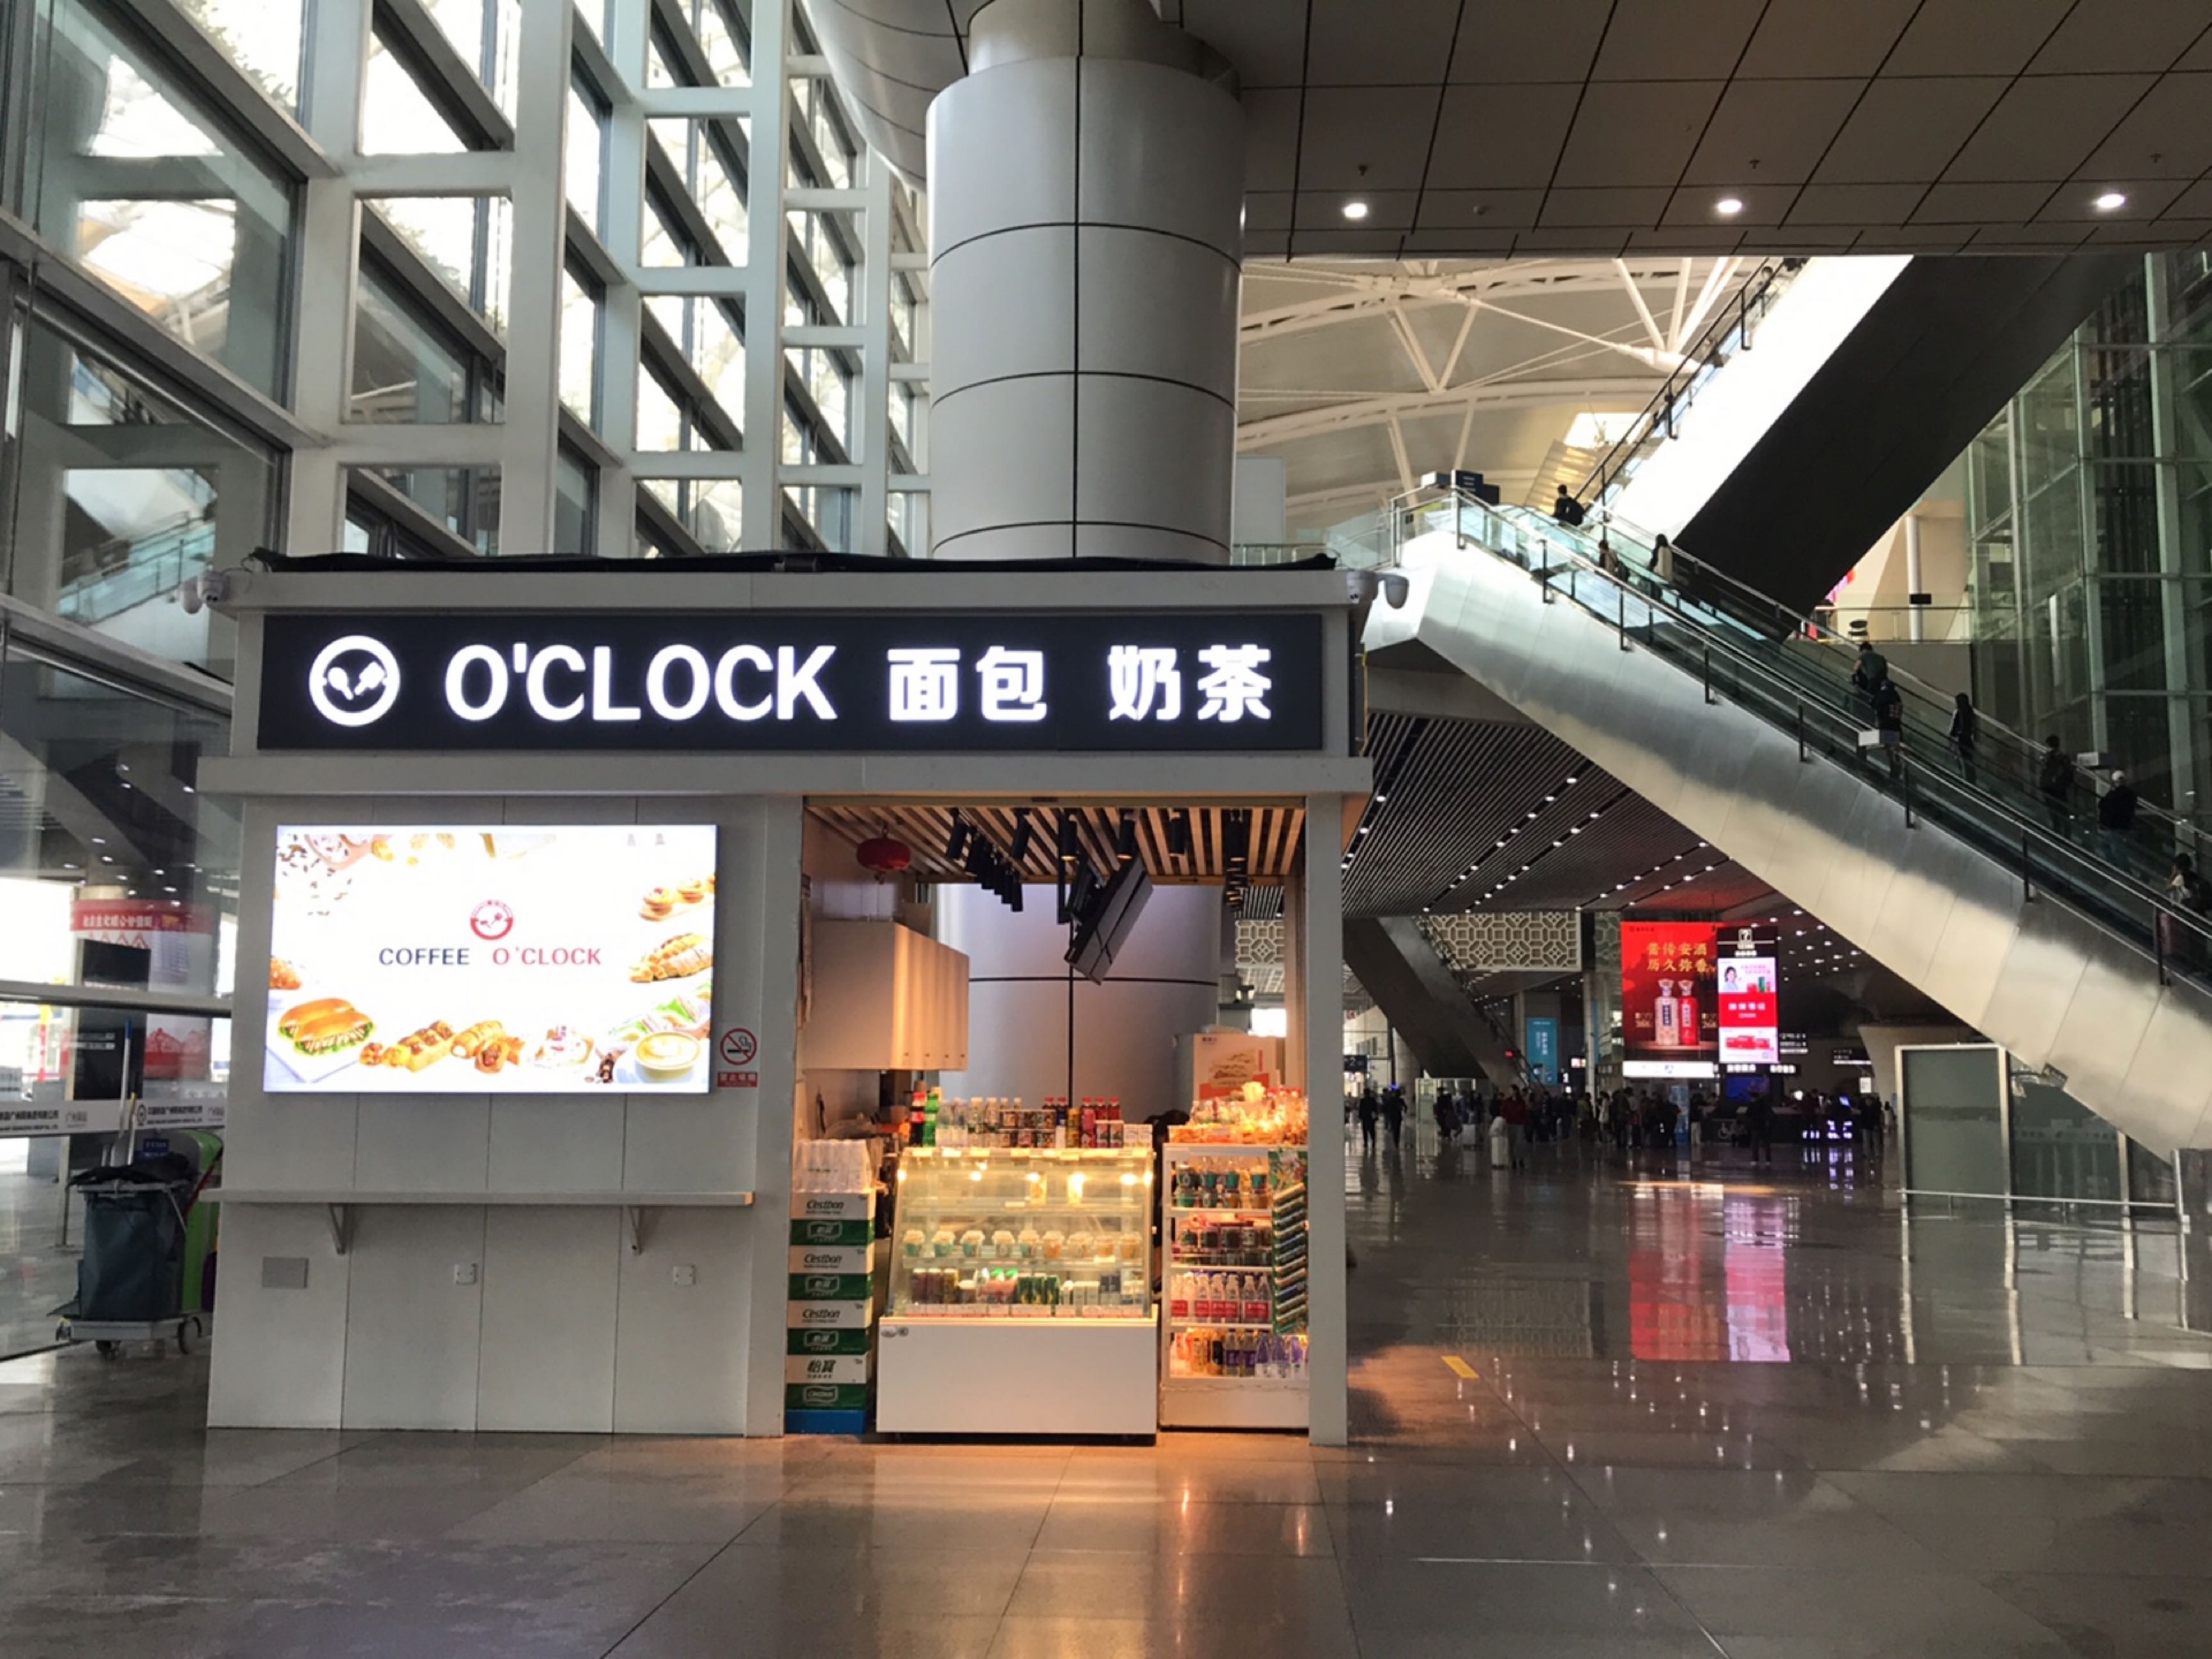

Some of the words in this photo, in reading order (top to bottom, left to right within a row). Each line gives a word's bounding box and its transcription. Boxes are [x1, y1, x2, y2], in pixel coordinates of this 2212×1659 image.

[445, 643, 838, 721] O'CLOCK
[887, 646, 1047, 721] 面包
[1107, 644, 1272, 722] 奶茶
[378, 947, 470, 966] COFFEE
